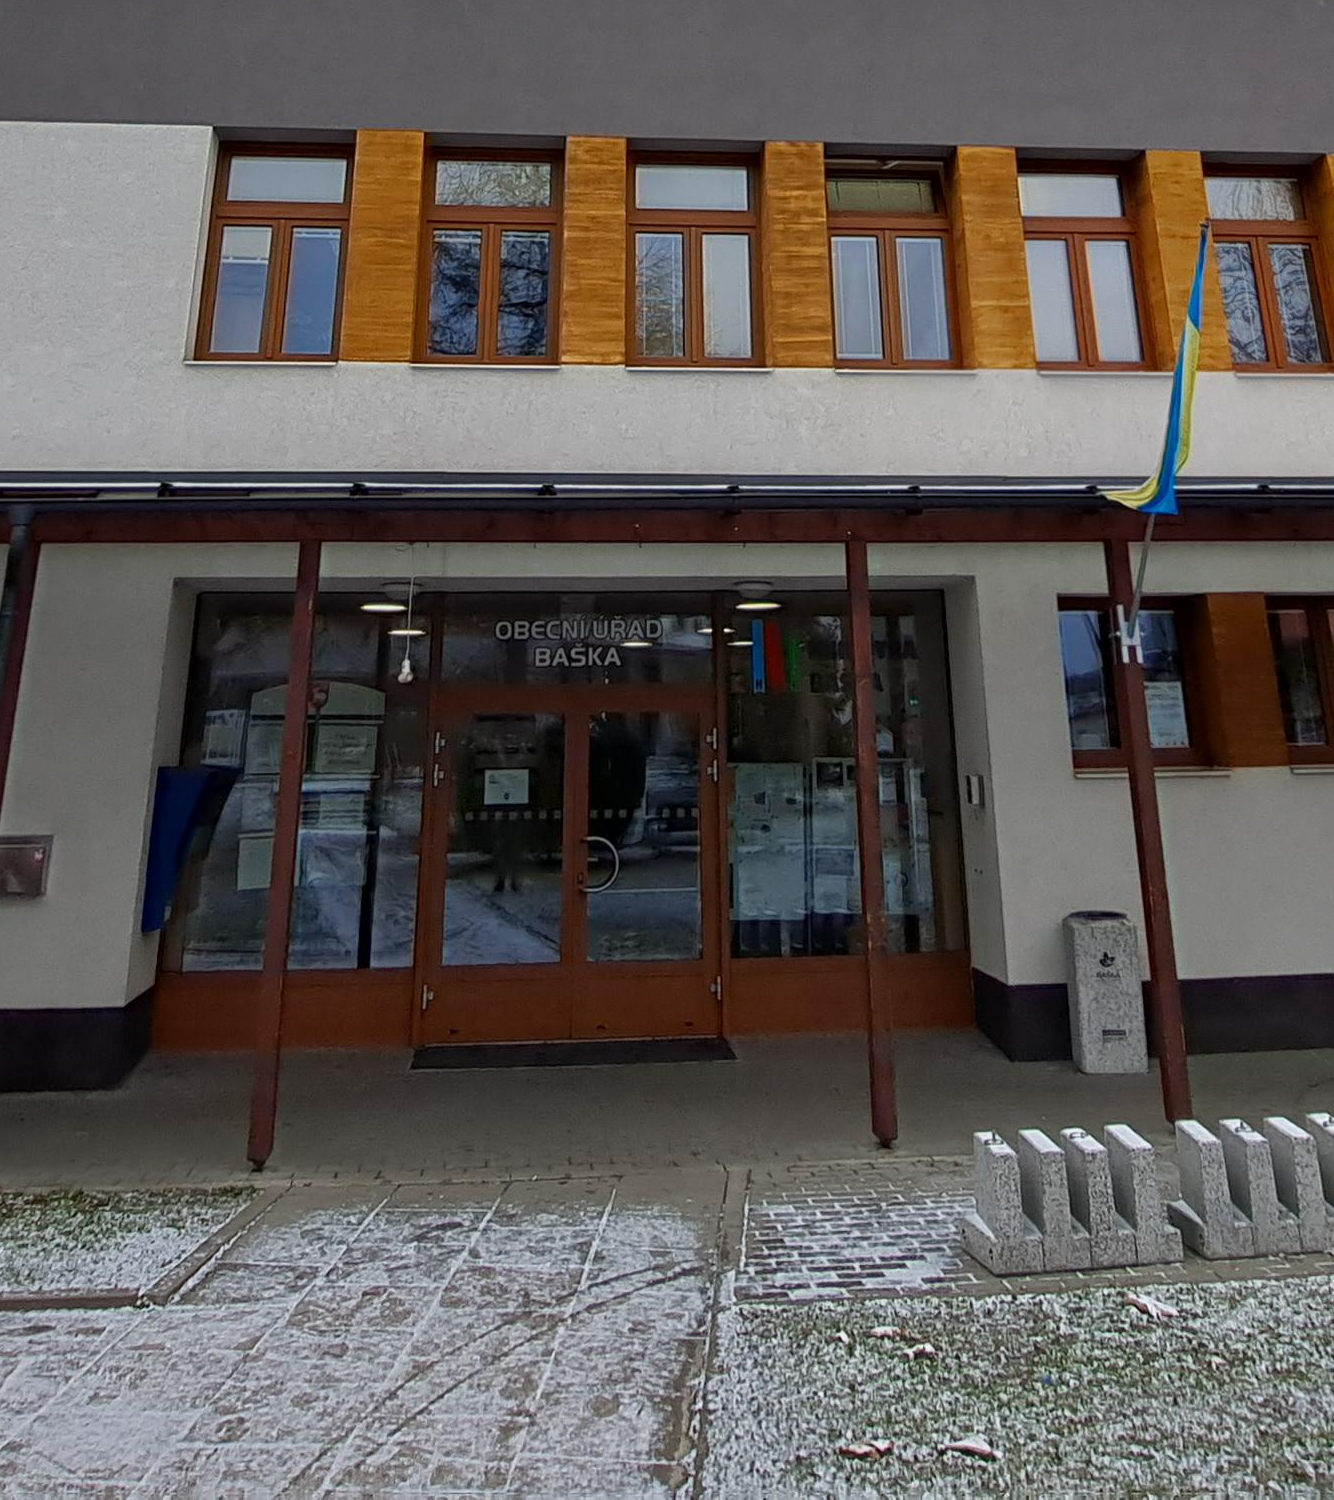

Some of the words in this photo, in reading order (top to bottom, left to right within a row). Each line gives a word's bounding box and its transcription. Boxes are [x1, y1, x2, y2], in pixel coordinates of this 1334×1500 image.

[495, 615, 587, 640] OBECNÍ
[593, 615, 663, 639] ÚŘAD
[534, 643, 622, 667] BAŠKA
